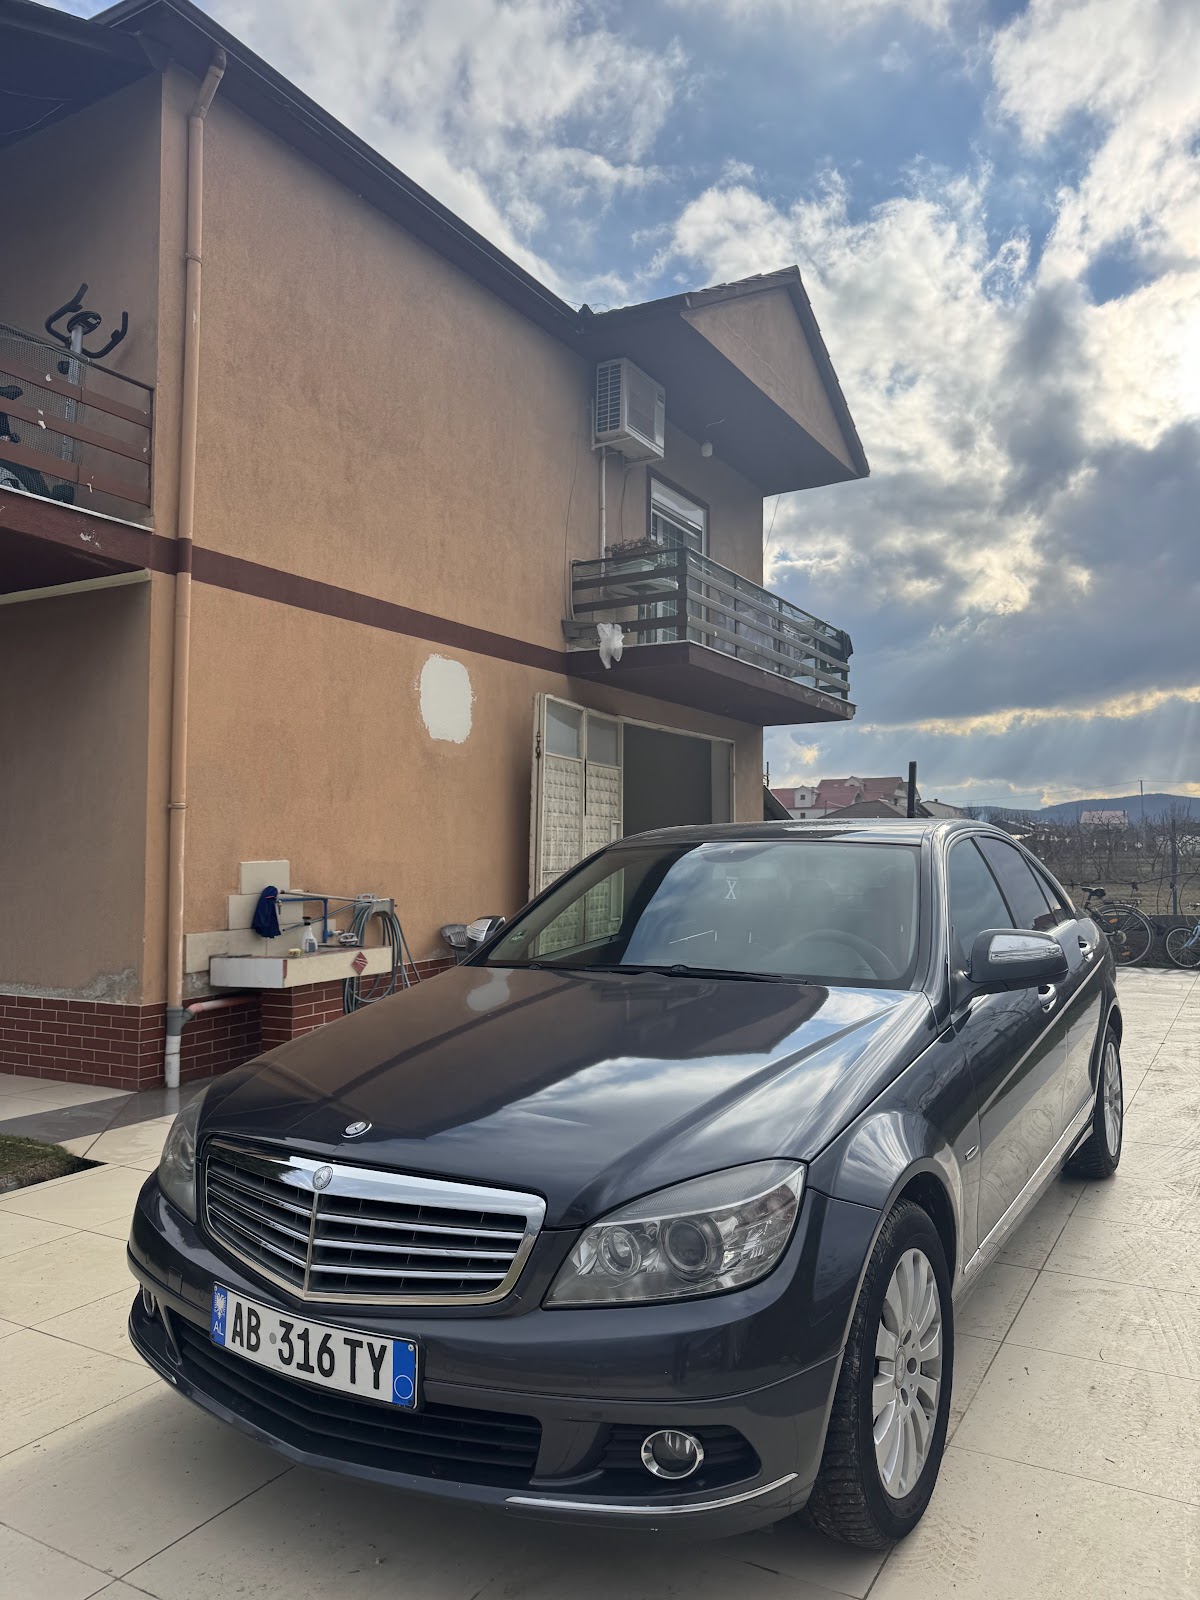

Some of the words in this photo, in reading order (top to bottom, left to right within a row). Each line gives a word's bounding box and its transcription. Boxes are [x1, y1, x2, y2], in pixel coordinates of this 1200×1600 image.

[213, 1320, 225, 1337] AL
[231, 1301, 261, 1352] AB
[277, 1319, 336, 1378] 316
[343, 1337, 388, 1390] TY
